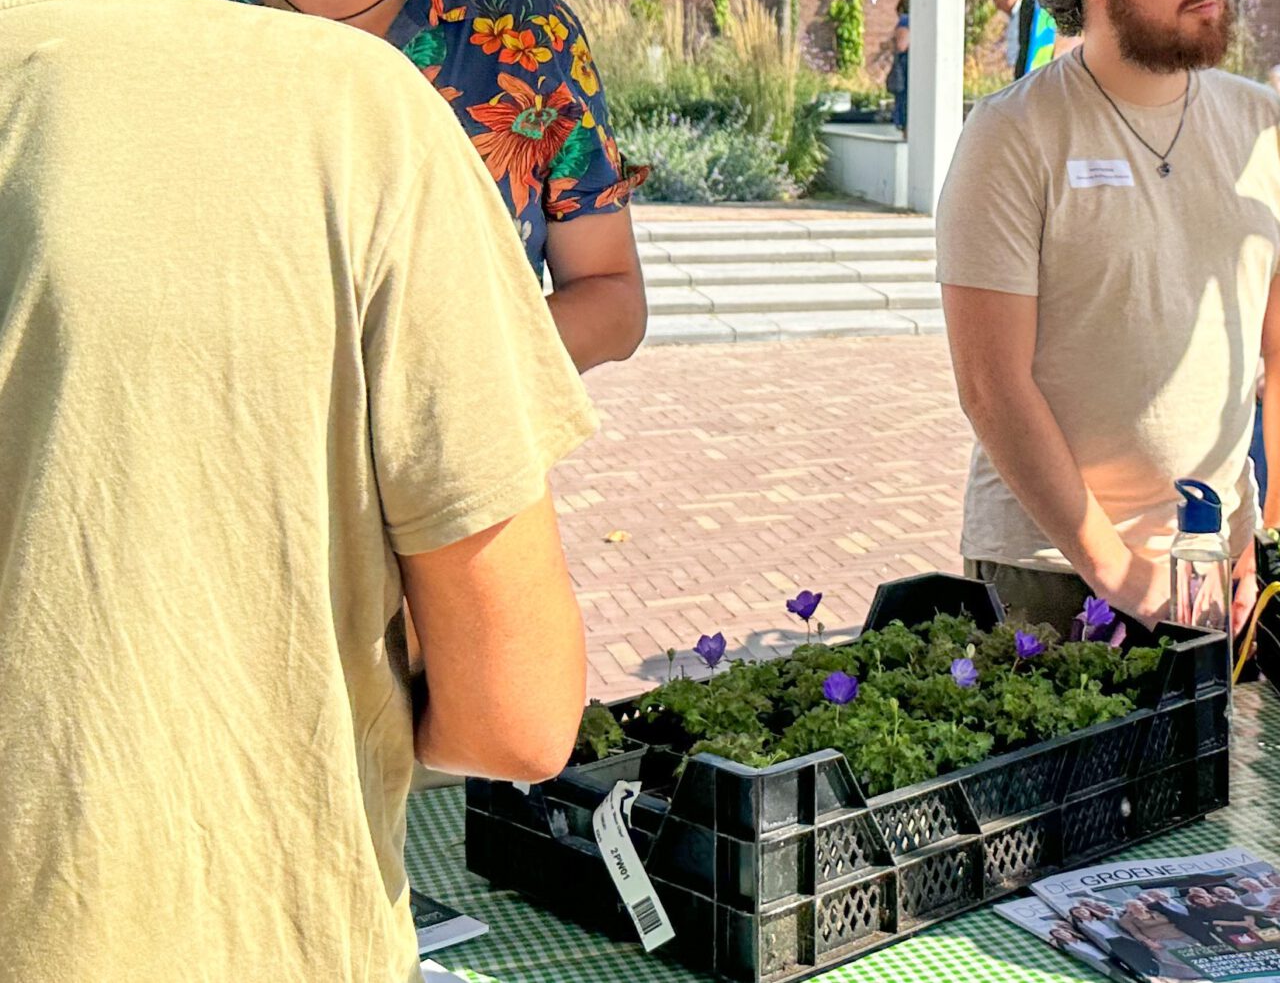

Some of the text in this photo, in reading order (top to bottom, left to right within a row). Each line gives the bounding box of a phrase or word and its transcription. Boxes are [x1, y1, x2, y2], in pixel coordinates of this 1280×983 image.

[610, 847, 631, 881] 2PW01
[1044, 853, 1254, 895] DE GROENE PLUIM
